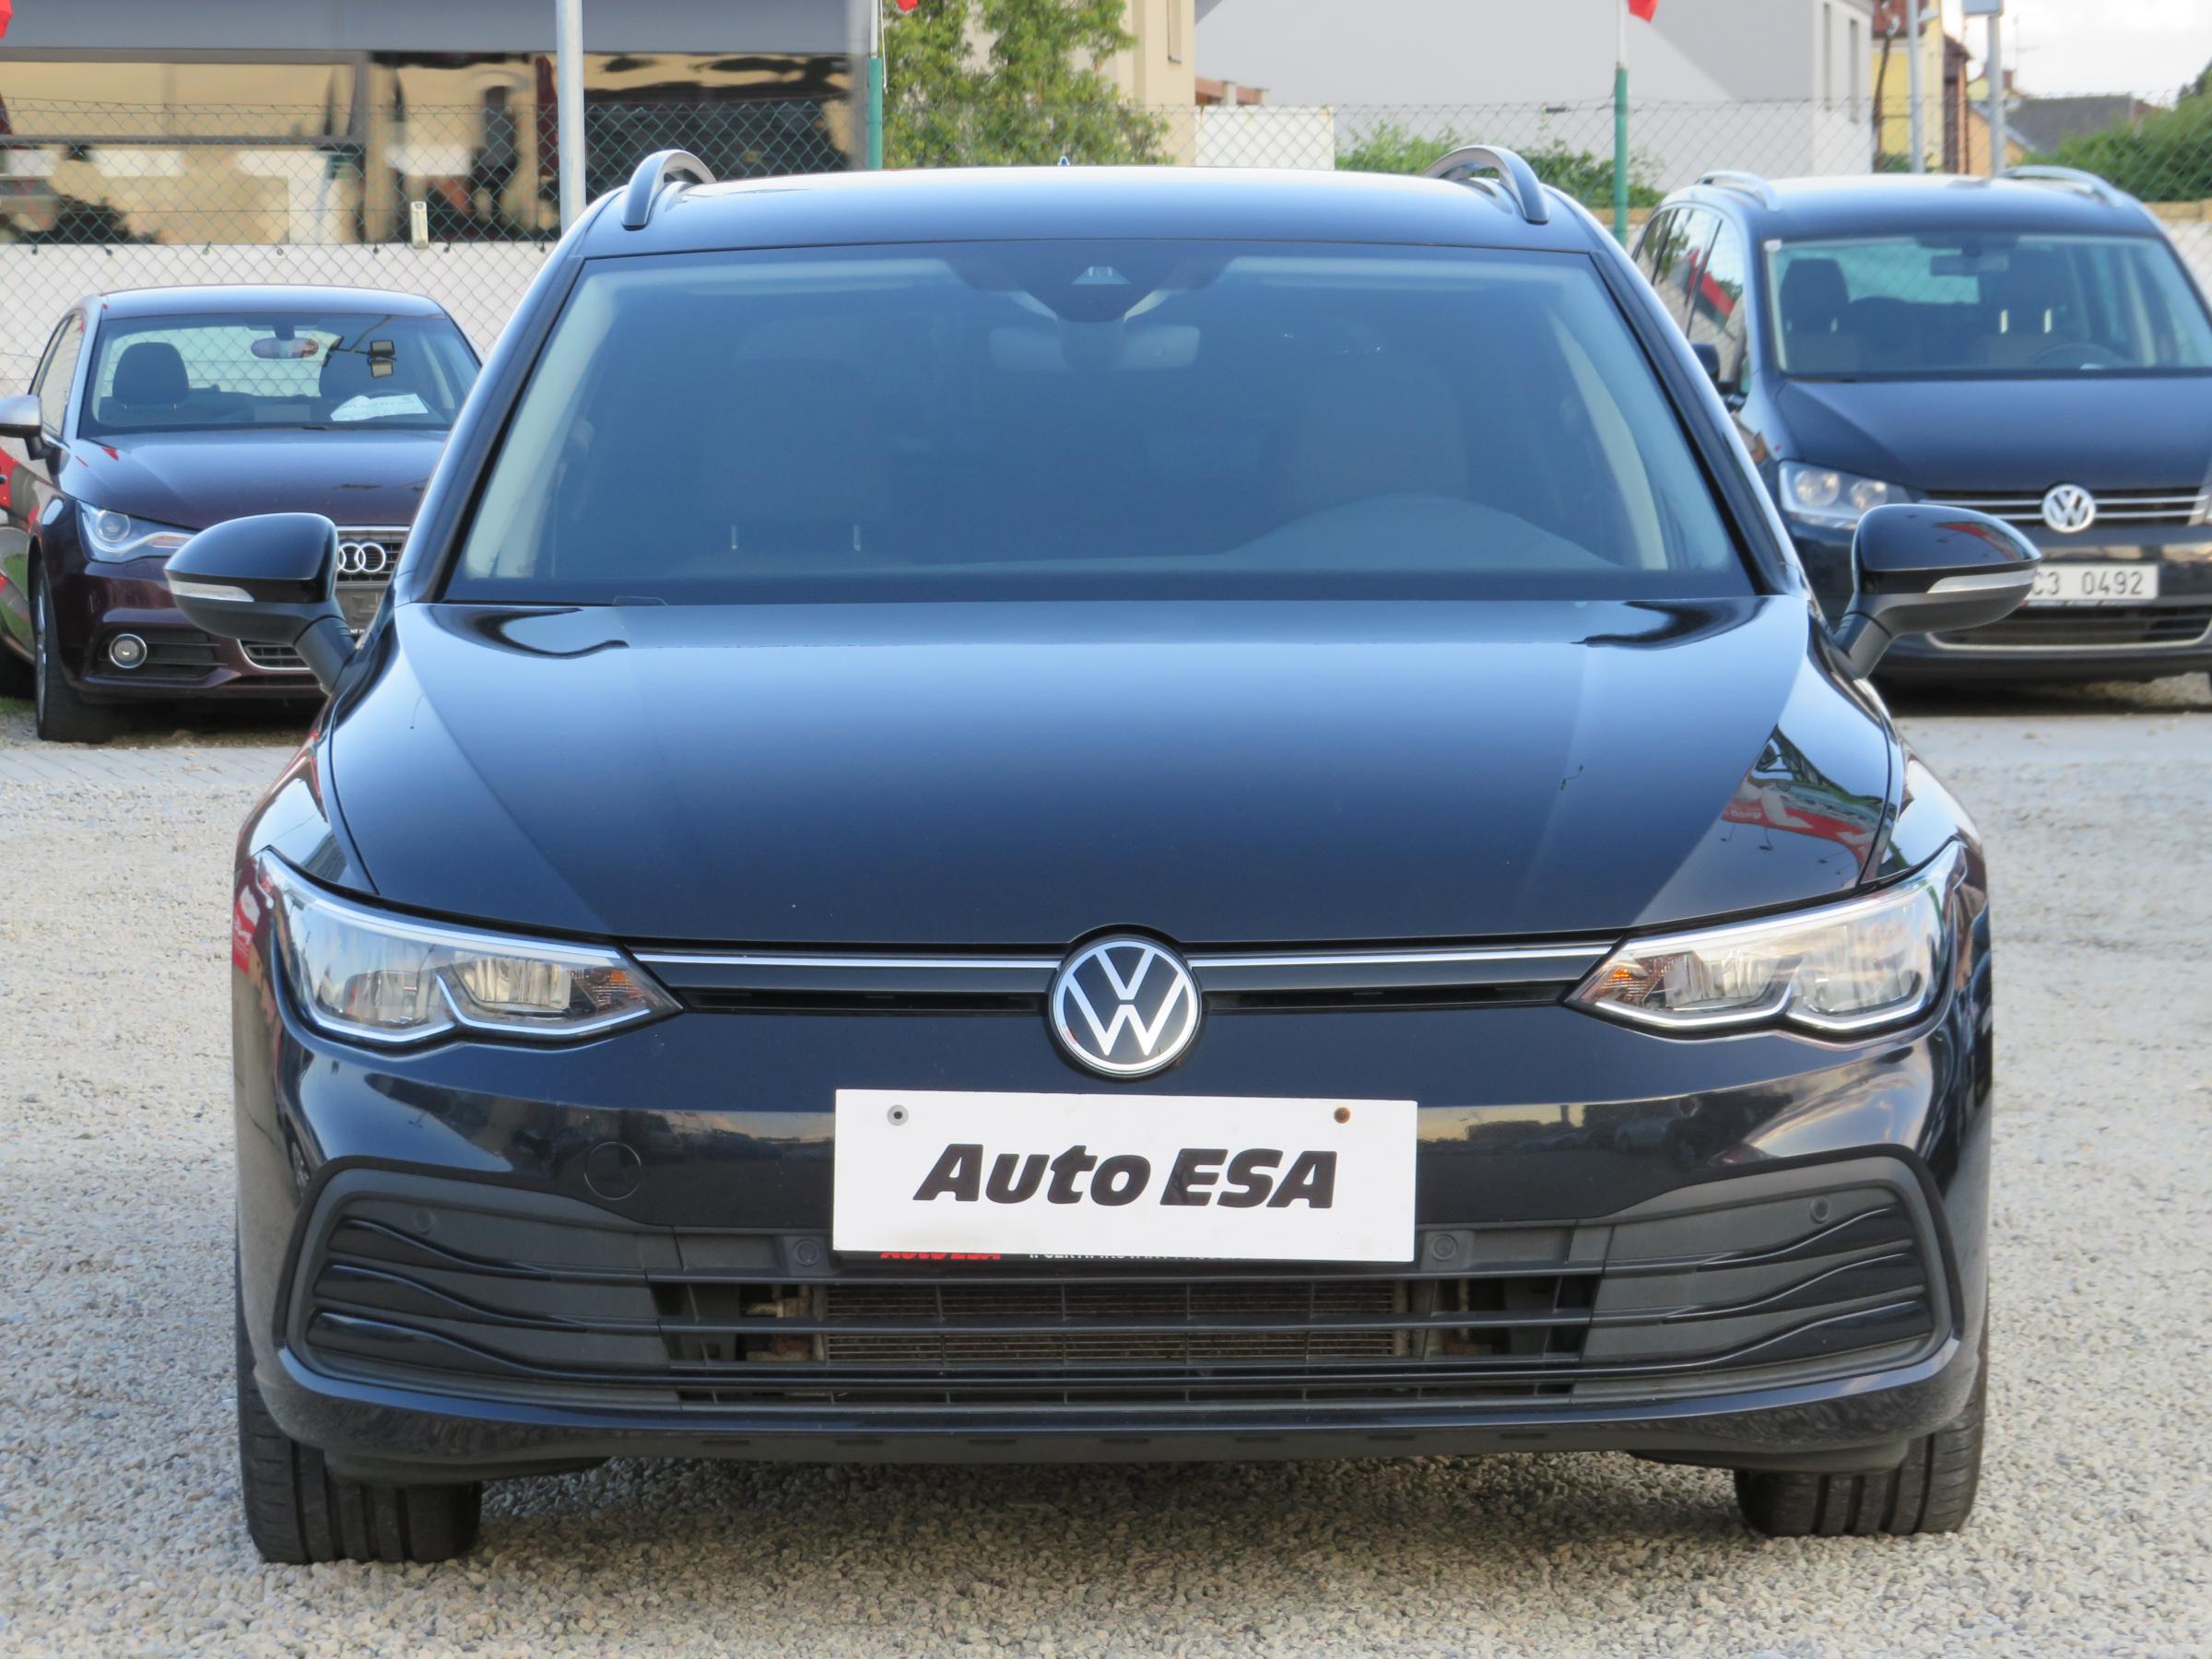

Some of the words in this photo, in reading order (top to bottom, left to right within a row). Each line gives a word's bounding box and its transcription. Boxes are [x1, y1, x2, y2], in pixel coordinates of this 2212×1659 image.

[2082, 571, 2143, 596] 0492
[1065, 947, 1188, 1060] VW
[912, 1143, 1151, 1206] Auto
[1159, 1147, 1337, 1208] ESA
